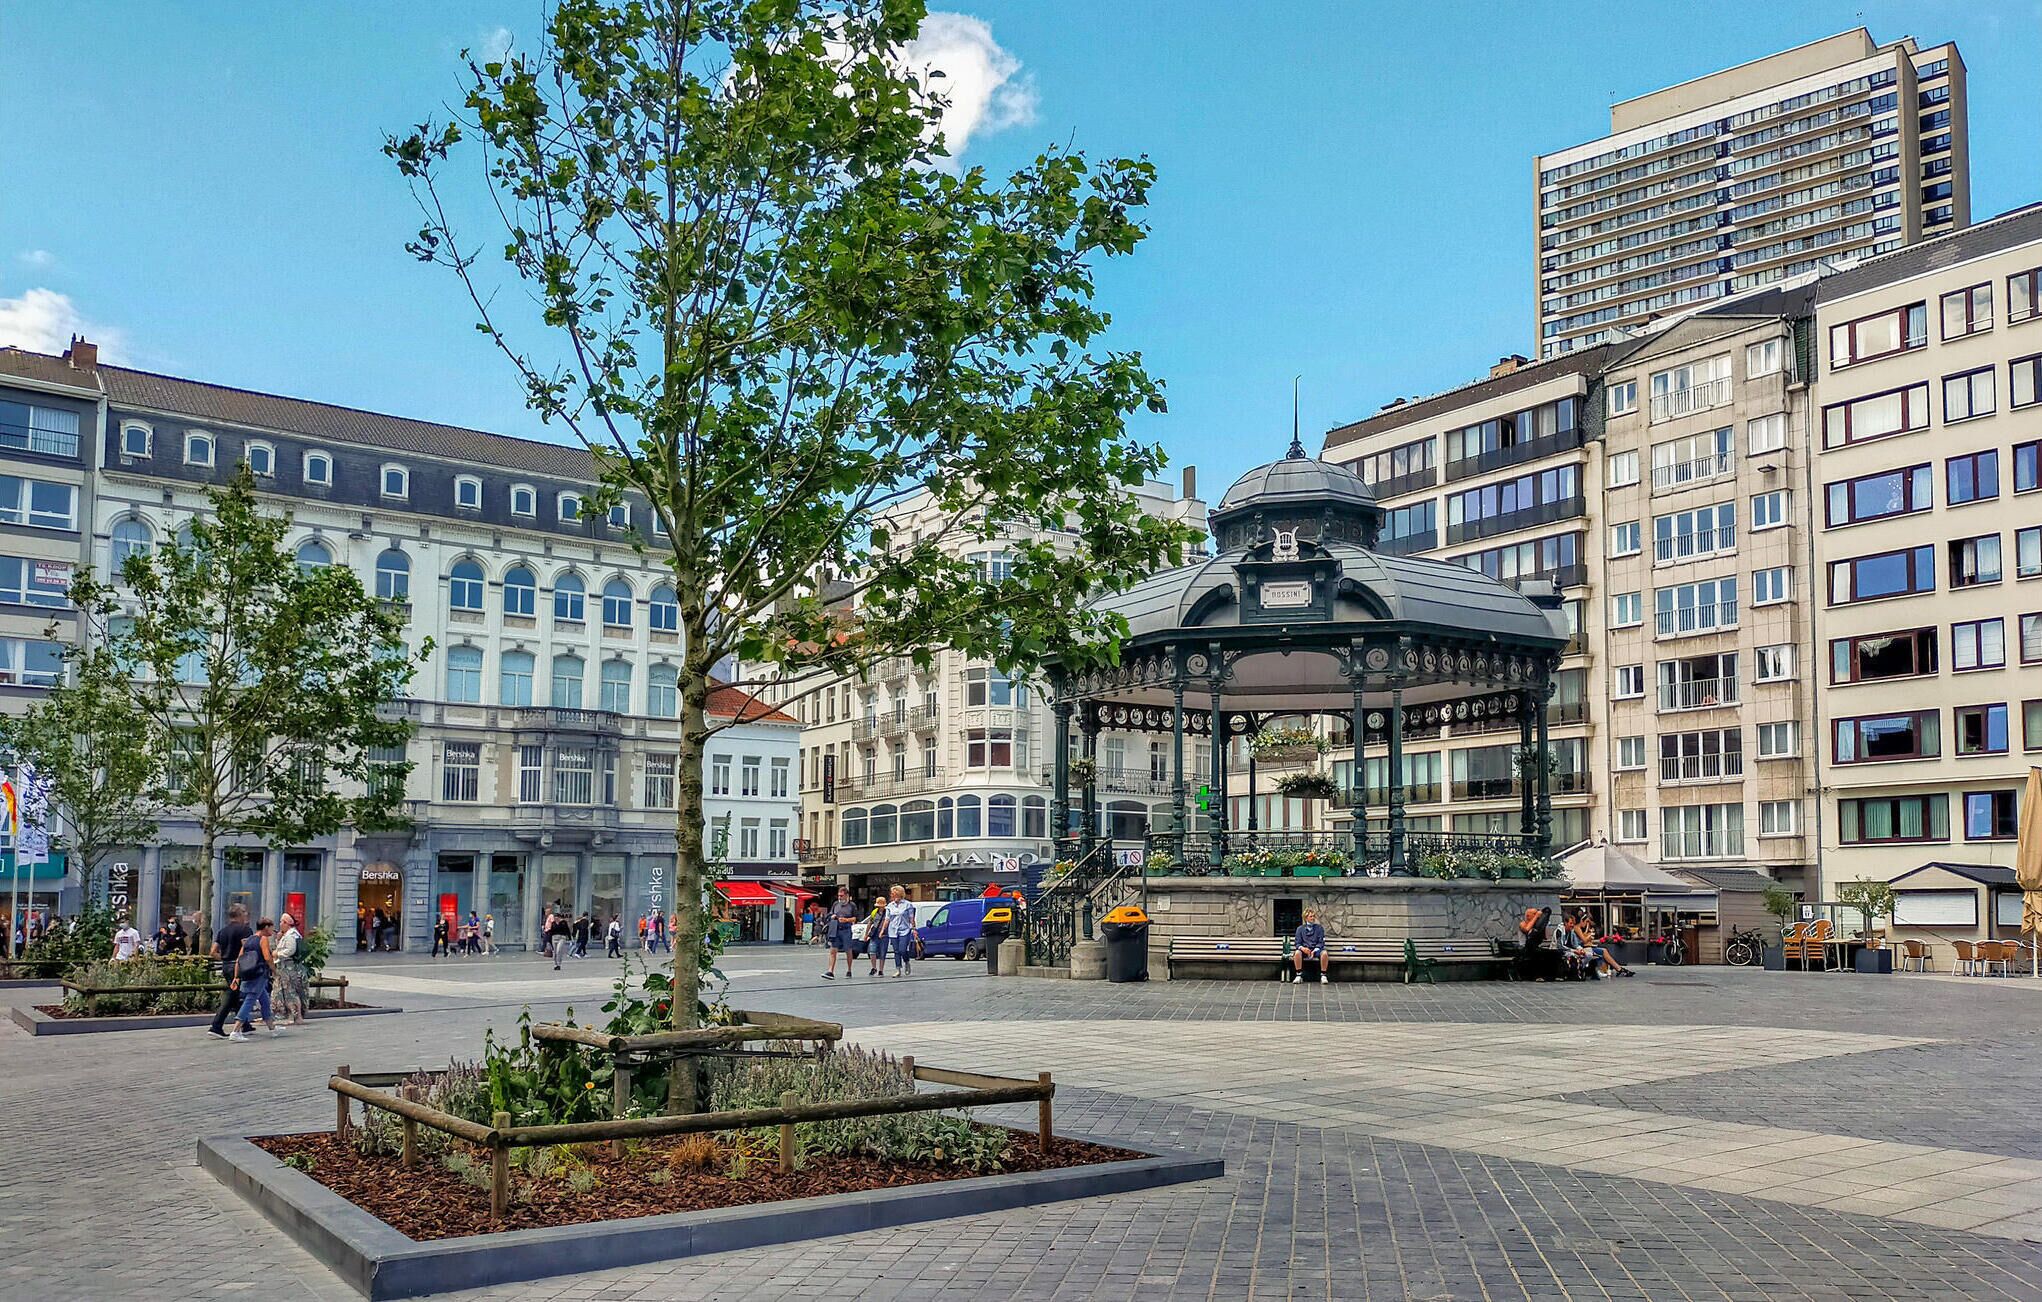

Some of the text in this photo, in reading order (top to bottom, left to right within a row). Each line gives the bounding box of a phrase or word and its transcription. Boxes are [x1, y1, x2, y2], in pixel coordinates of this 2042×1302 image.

[446, 749, 475, 759] Bershka
[559, 752, 586, 762] Bershka
[646, 760, 672, 769] Bershka
[362, 870, 399, 880] Bershka
[648, 867, 663, 917] ershka
